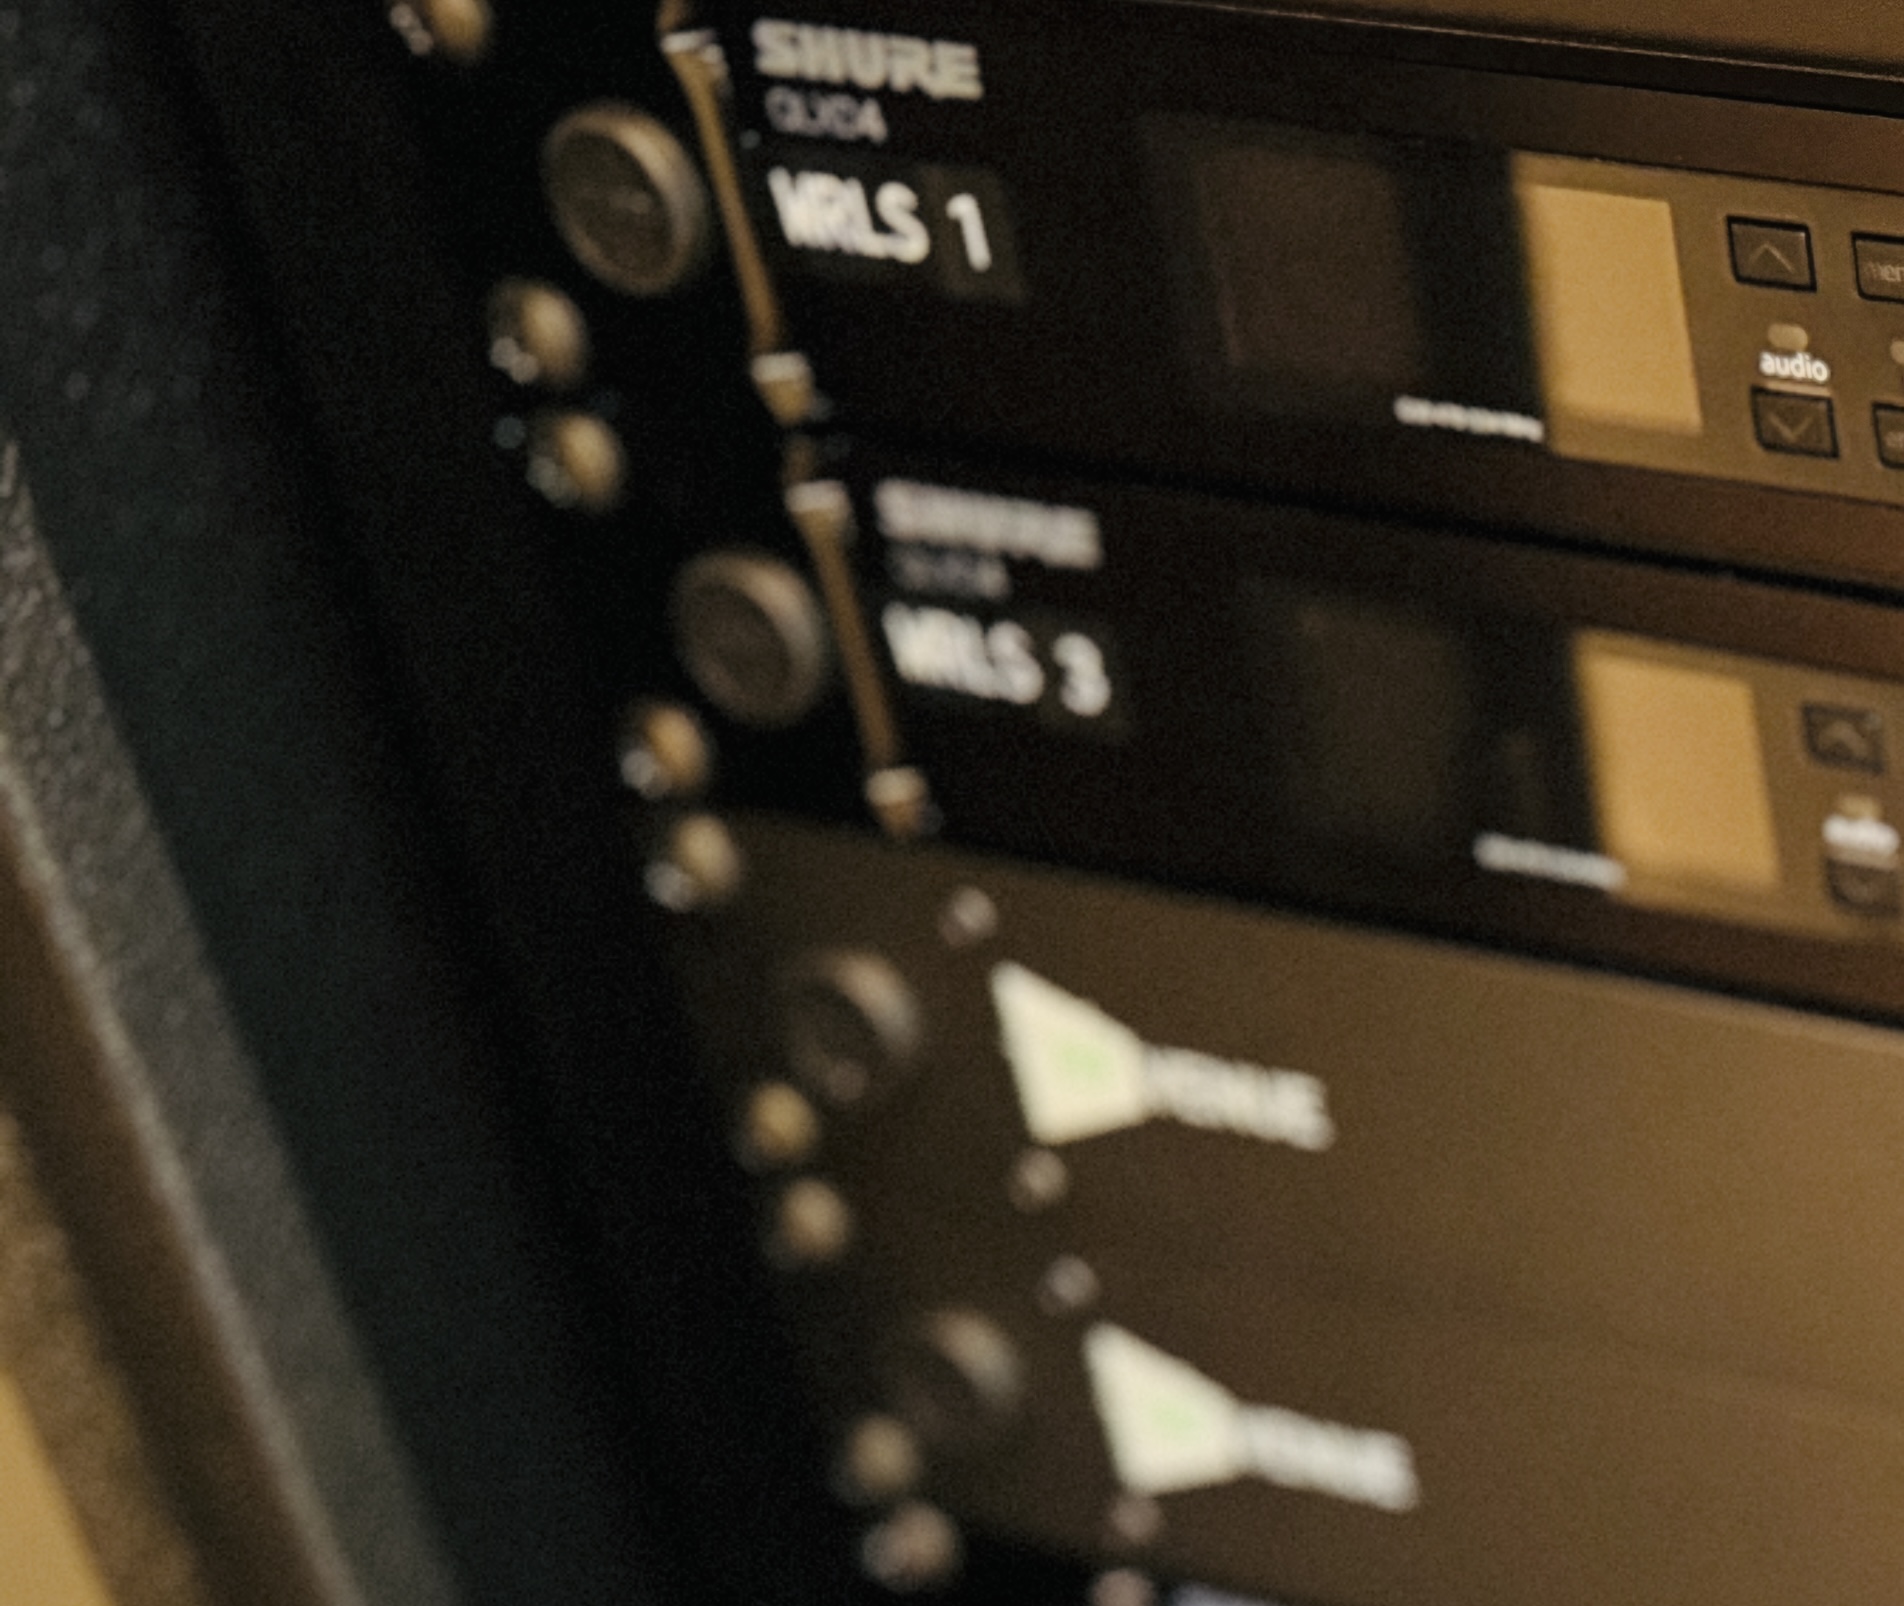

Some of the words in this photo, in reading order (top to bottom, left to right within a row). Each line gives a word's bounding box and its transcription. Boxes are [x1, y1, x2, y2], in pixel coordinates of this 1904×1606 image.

[752, 18, 984, 101] SHURE
[768, 166, 930, 264] WRLS
[945, 193, 992, 272] 1
[1759, 350, 1831, 384] audio
